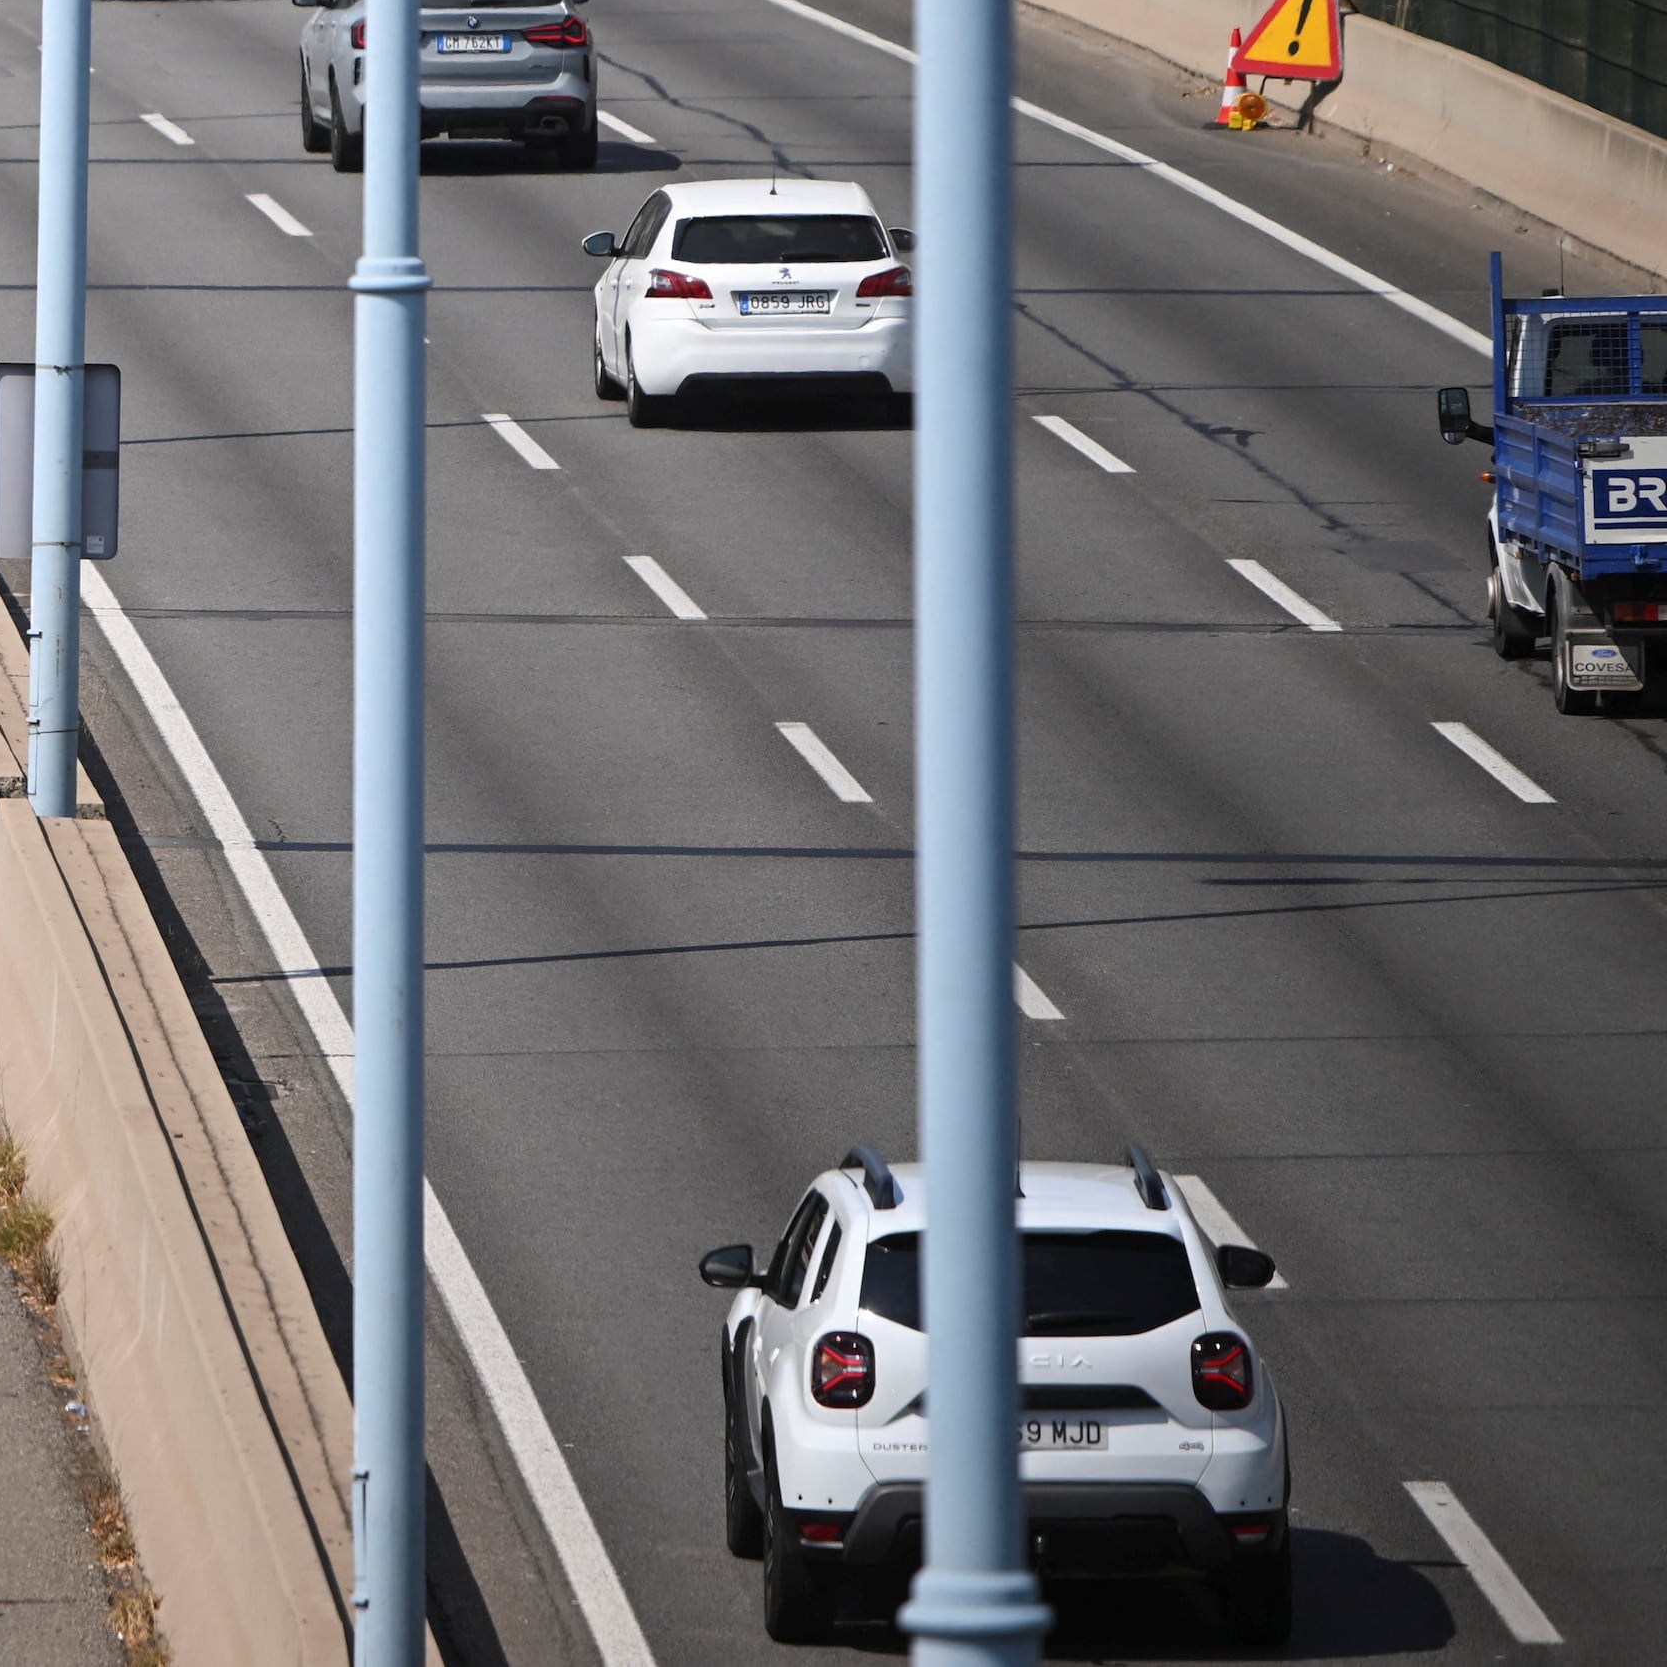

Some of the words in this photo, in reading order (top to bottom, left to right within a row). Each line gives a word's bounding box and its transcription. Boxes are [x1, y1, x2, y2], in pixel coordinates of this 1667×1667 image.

[751, 296, 791, 310] 0859
[797, 295, 825, 309] JRG
[1052, 1419, 1101, 1445] MJD
